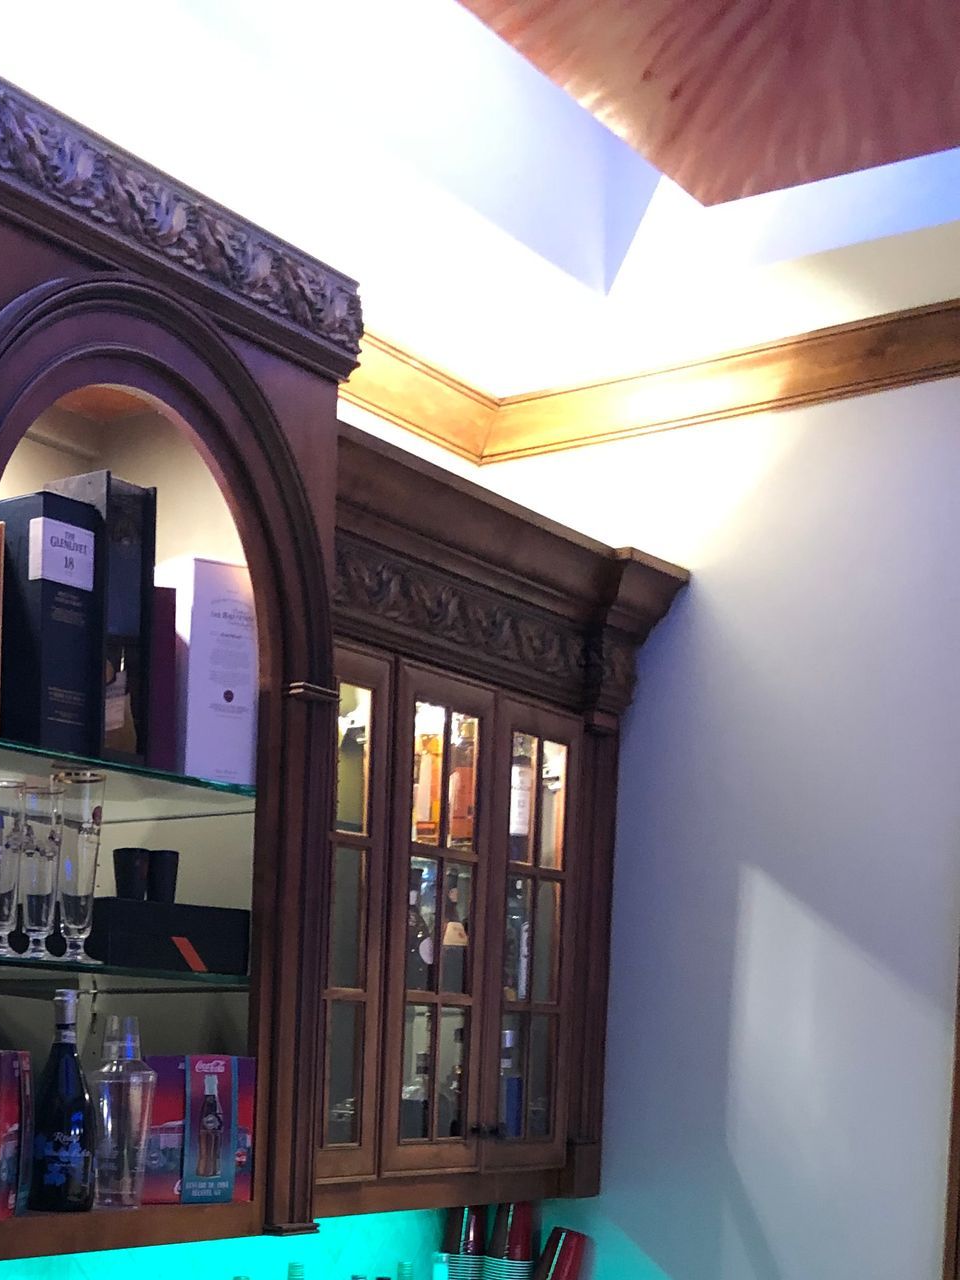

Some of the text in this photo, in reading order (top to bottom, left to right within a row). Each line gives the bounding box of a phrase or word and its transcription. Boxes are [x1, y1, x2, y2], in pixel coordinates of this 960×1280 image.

[50, 535, 88, 555] GLENLIVET
[64, 556, 75, 571] 18
[195, 1059, 227, 1073] Coca-Cola
